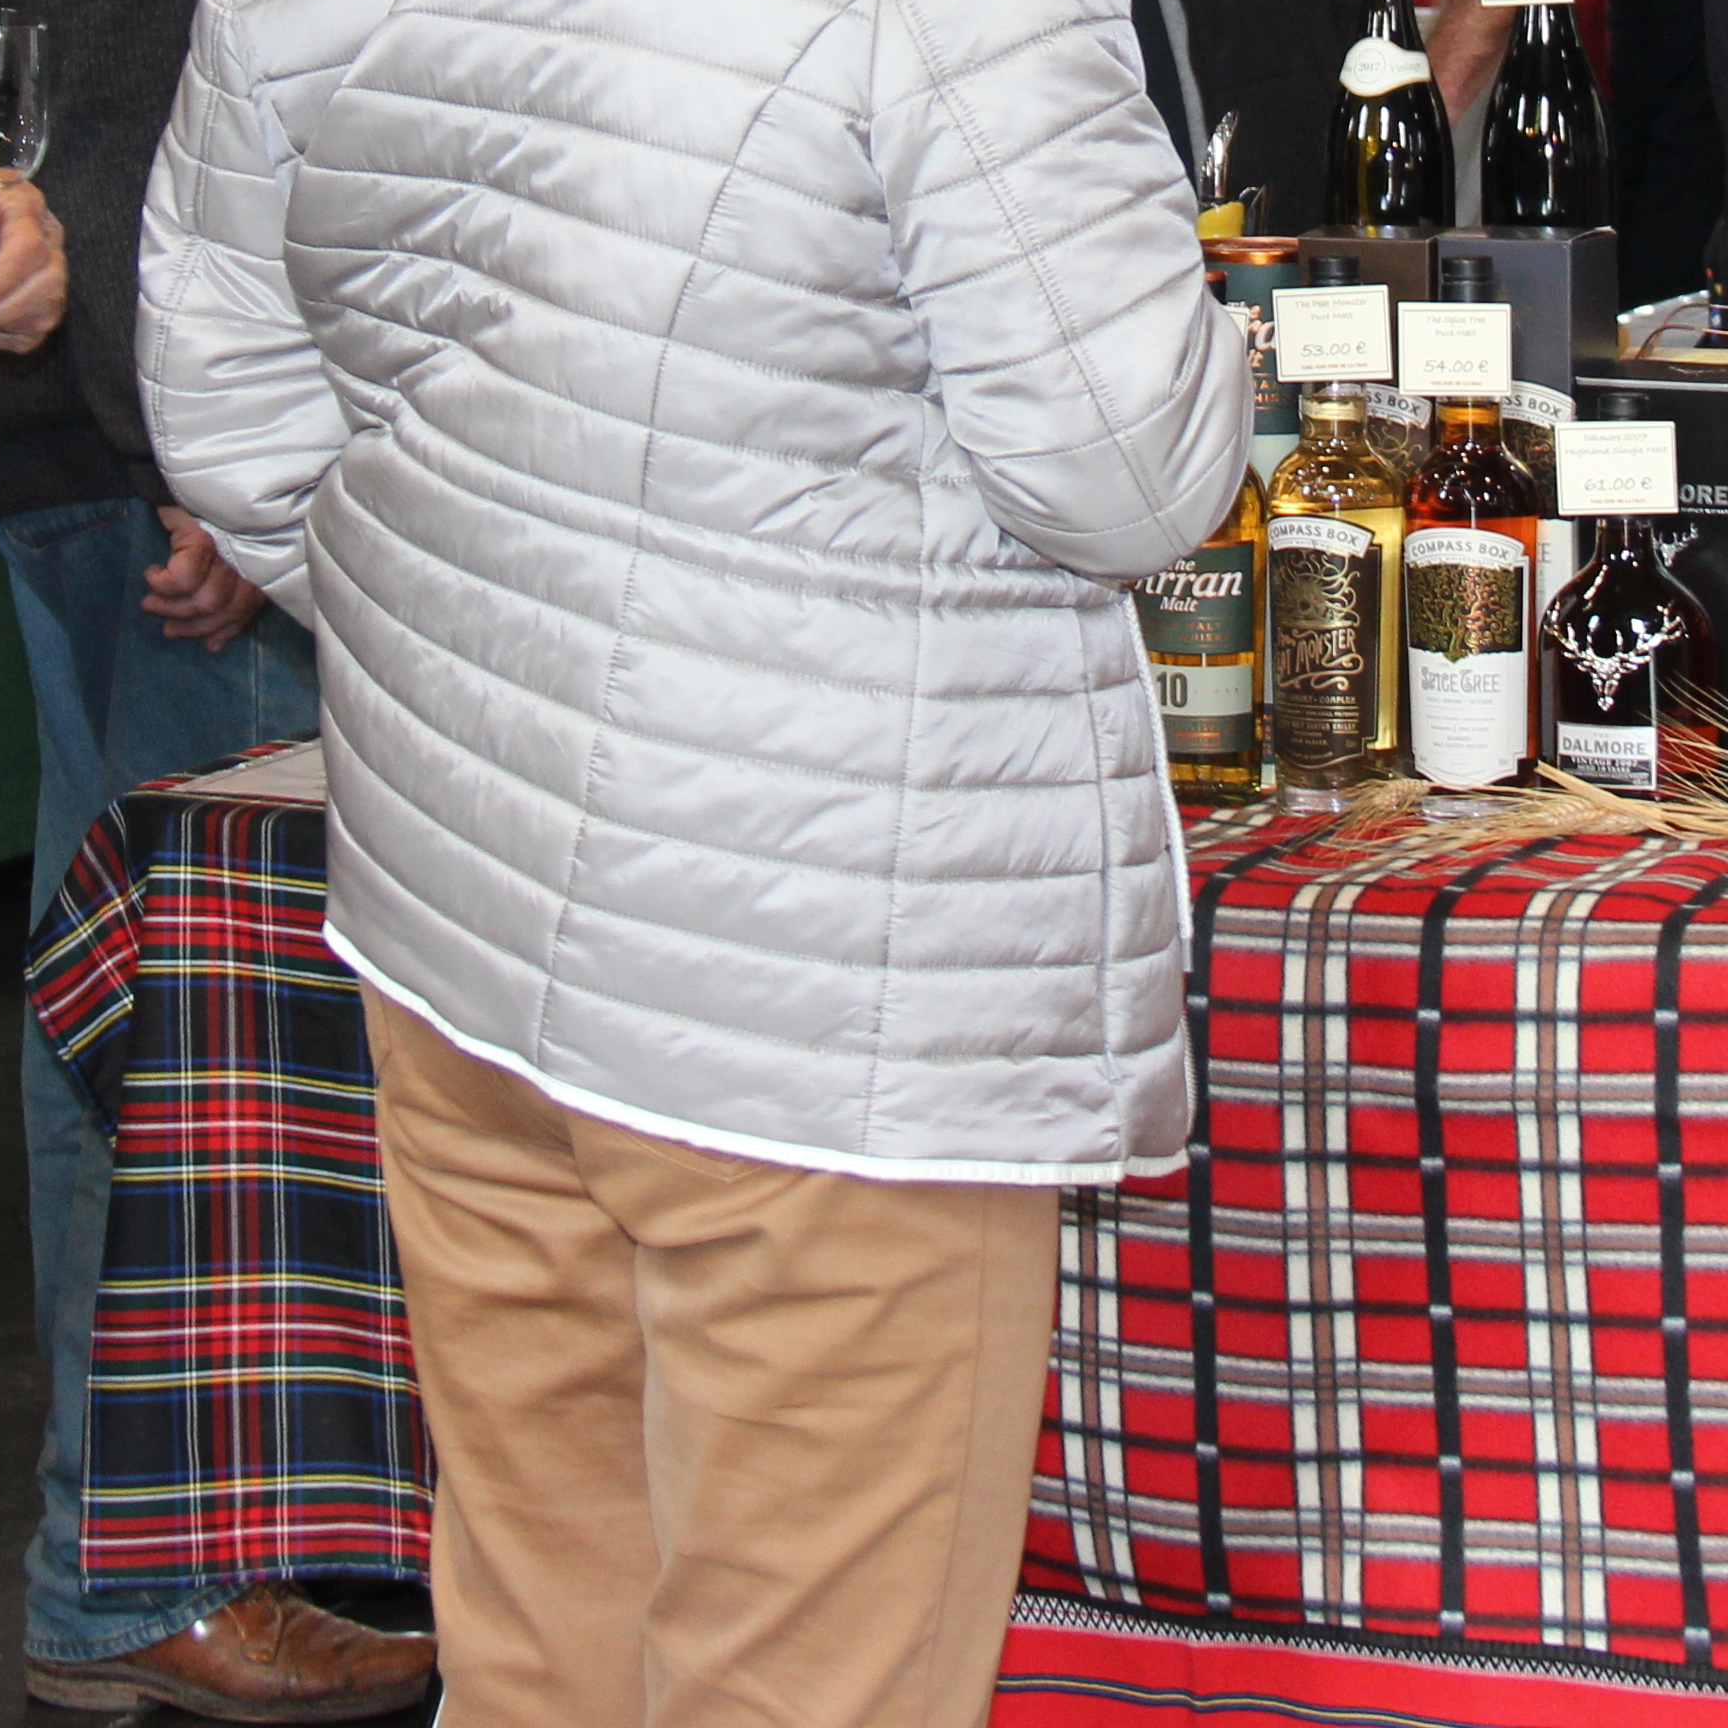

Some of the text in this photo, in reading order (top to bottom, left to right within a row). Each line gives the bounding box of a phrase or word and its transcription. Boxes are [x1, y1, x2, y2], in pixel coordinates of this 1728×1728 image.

[1358, 61, 1381, 72] 2017
[1294, 300, 1310, 308] The
[1332, 297, 1367, 307] Monster
[1310, 311, 1353, 321] Pure Malt
[1426, 315, 1442, 324] The
[1444, 315, 1466, 326] Spice
[1435, 329, 1477, 337] Pure Malt
[1300, 340, 1367, 358] 53.00 €
[1423, 359, 1489, 374] 54.00 €
[1387, 396, 1421, 415] BOX
[1528, 398, 1562, 419] BOX
[1583, 433, 1621, 442] Dalmore
[1583, 476, 1653, 492] 61.00 €
[1326, 528, 1359, 547] BOX
[1411, 540, 1509, 561] COMPASS BOX
[1175, 557, 1195, 571] he
[1159, 596, 1199, 612] Malt
[1156, 672, 1188, 707] 10
[1562, 736, 1647, 756] DALMORE
